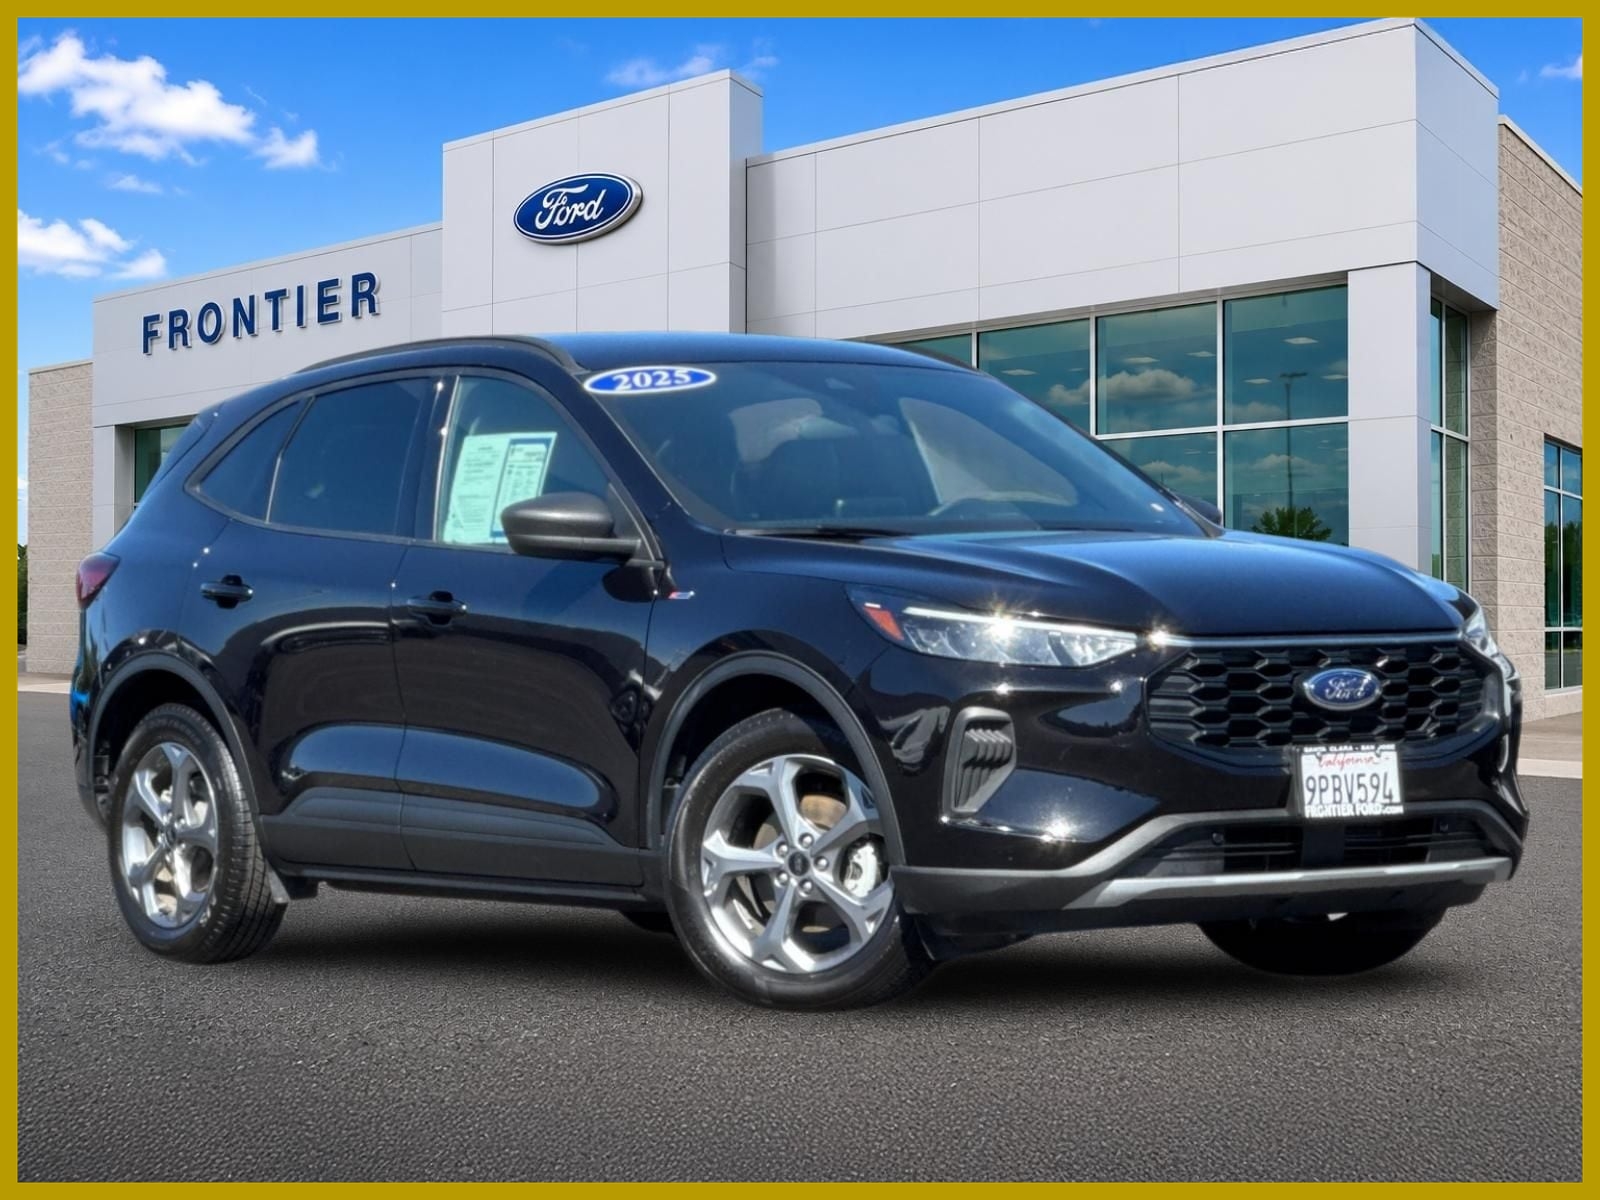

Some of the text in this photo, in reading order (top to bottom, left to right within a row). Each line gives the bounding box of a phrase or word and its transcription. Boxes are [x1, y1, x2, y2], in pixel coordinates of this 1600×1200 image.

[535, 183, 605, 230] Ford
[142, 271, 380, 355] FRONTIER
[612, 369, 692, 392] 2025
[1324, 676, 1370, 700] Ford
[1320, 753, 1375, 770] California
[1305, 772, 1394, 805] 9PBV594
